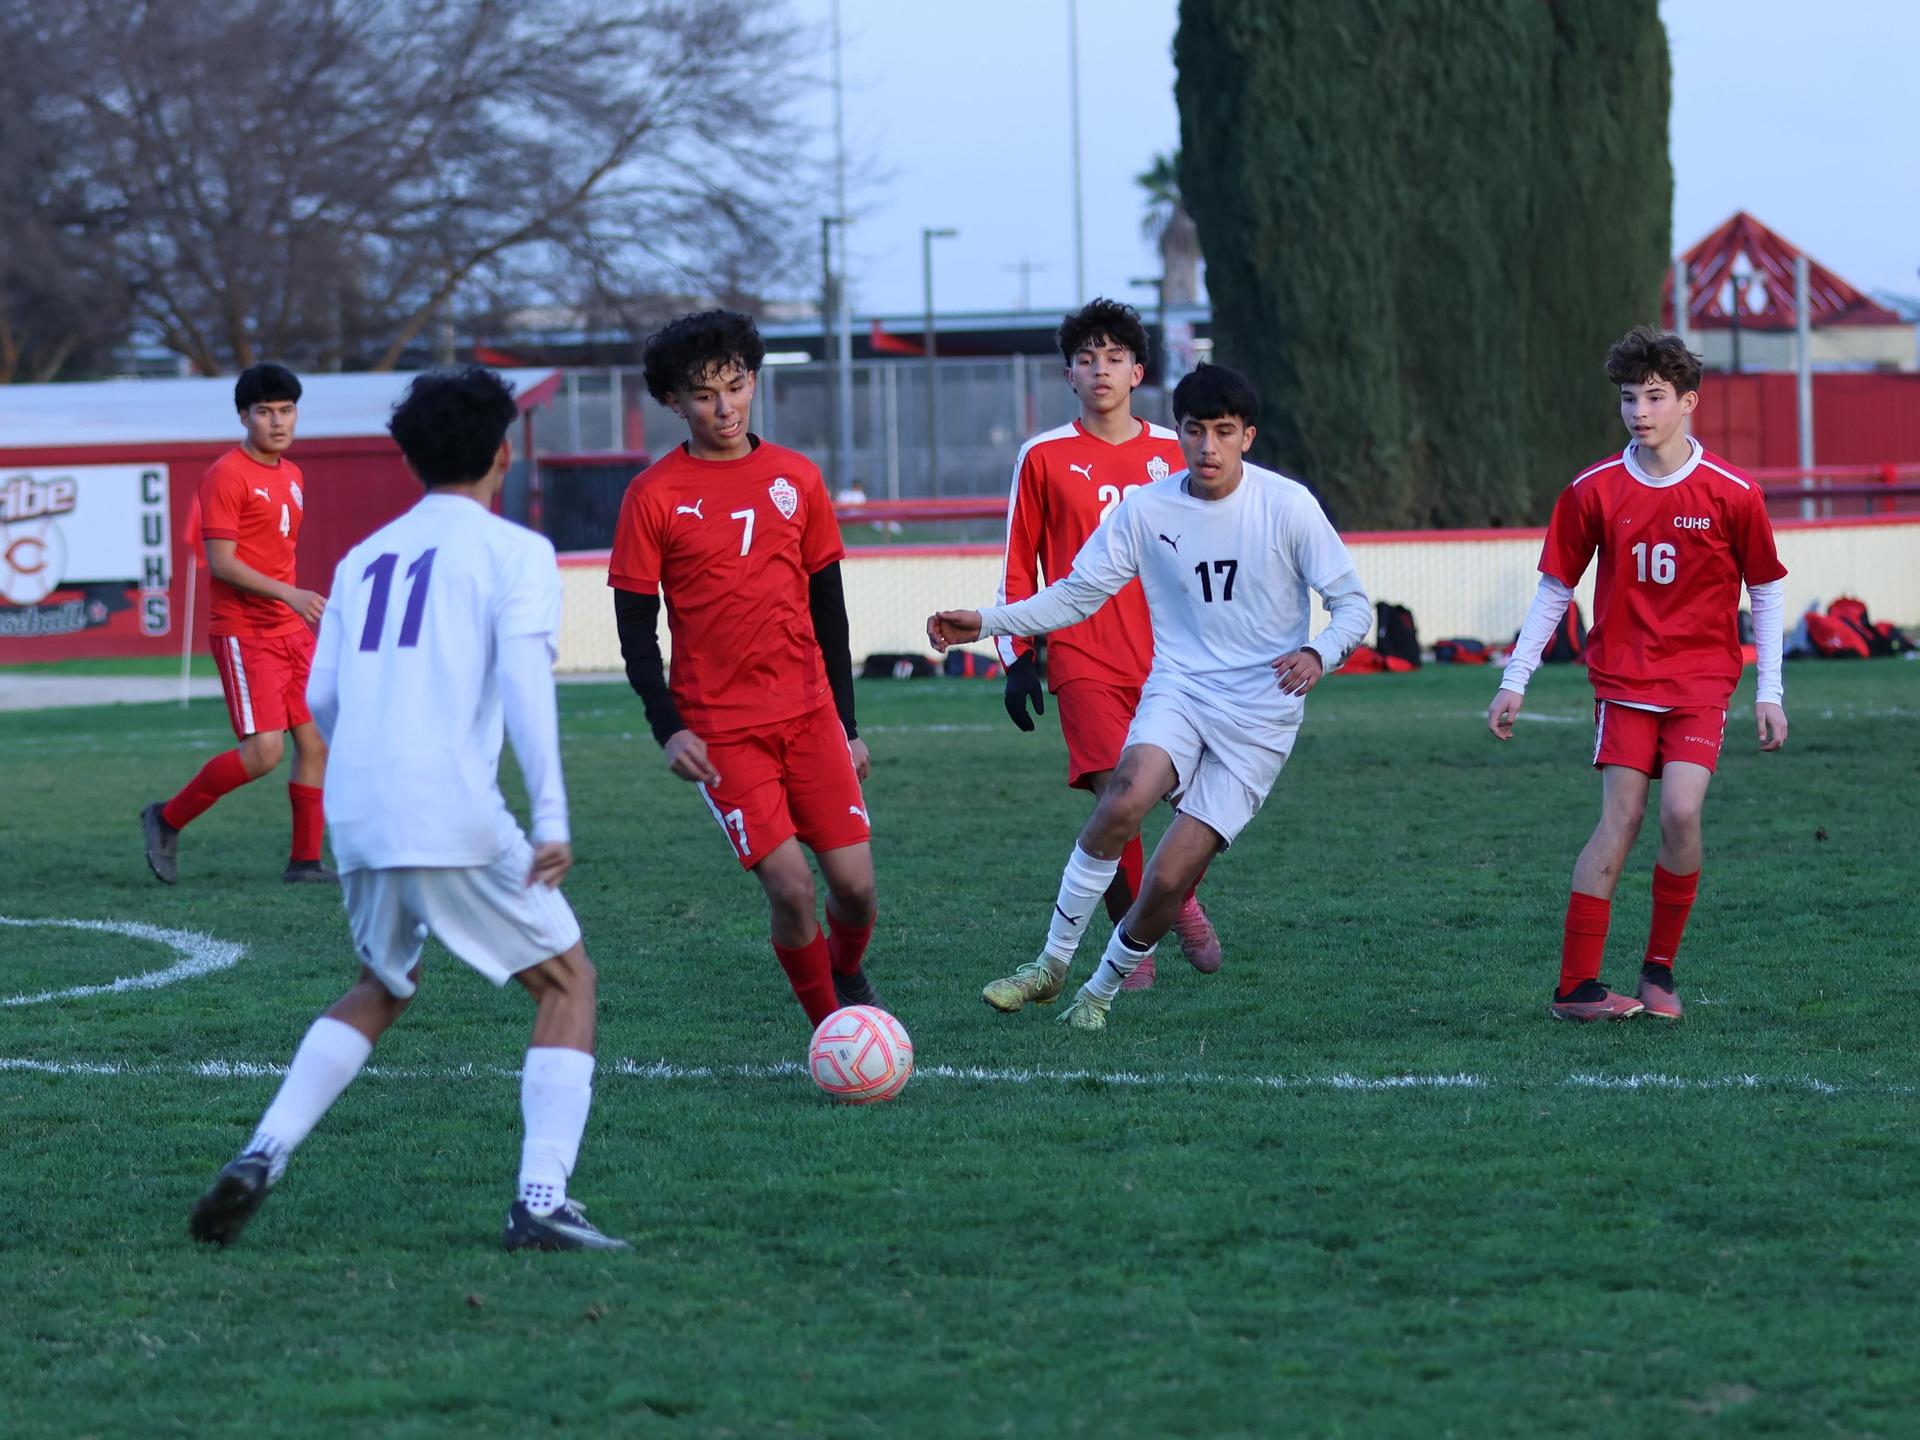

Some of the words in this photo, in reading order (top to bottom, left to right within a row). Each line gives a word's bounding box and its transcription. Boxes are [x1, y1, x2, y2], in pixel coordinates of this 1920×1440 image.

[279, 503, 290, 537] 4
[1098, 484, 1141, 524] 2
[1673, 516, 1711, 530] CUHS
[141, 471, 165, 630] CUHS
[730, 508, 755, 557] 7
[5, 537, 48, 575] C
[1631, 542, 1676, 585] 16
[359, 547, 438, 652] 11
[1195, 559, 1238, 603] 17
[725, 808, 751, 856] 7
